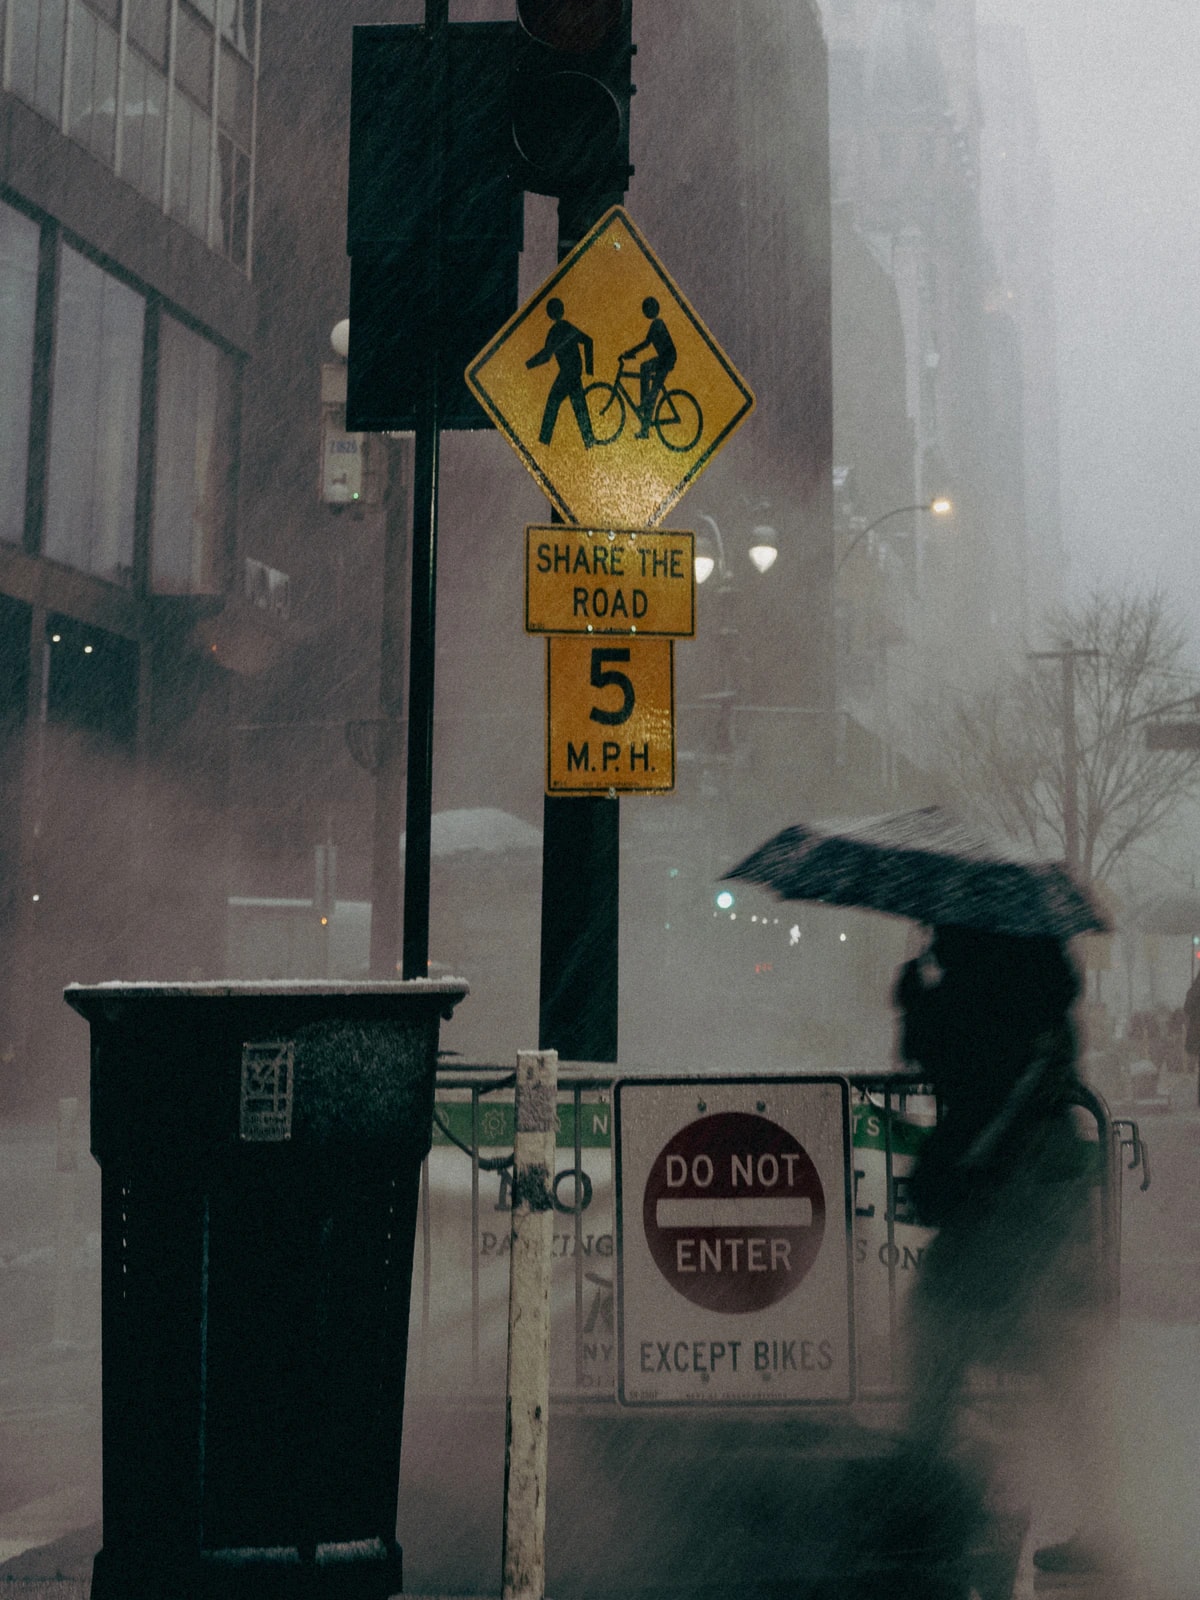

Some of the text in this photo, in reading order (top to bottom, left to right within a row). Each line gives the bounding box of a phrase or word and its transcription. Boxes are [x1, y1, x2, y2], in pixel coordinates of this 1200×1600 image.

[536, 543, 685, 578] SHARE THE
[572, 586, 649, 619] ROAD
[589, 647, 636, 727] 5
[567, 741, 656, 772] M.P.H.
[666, 1153, 800, 1188] DO NOT
[676, 1238, 792, 1273] ENTER
[639, 1340, 832, 1372] EXCEPT BIKES
